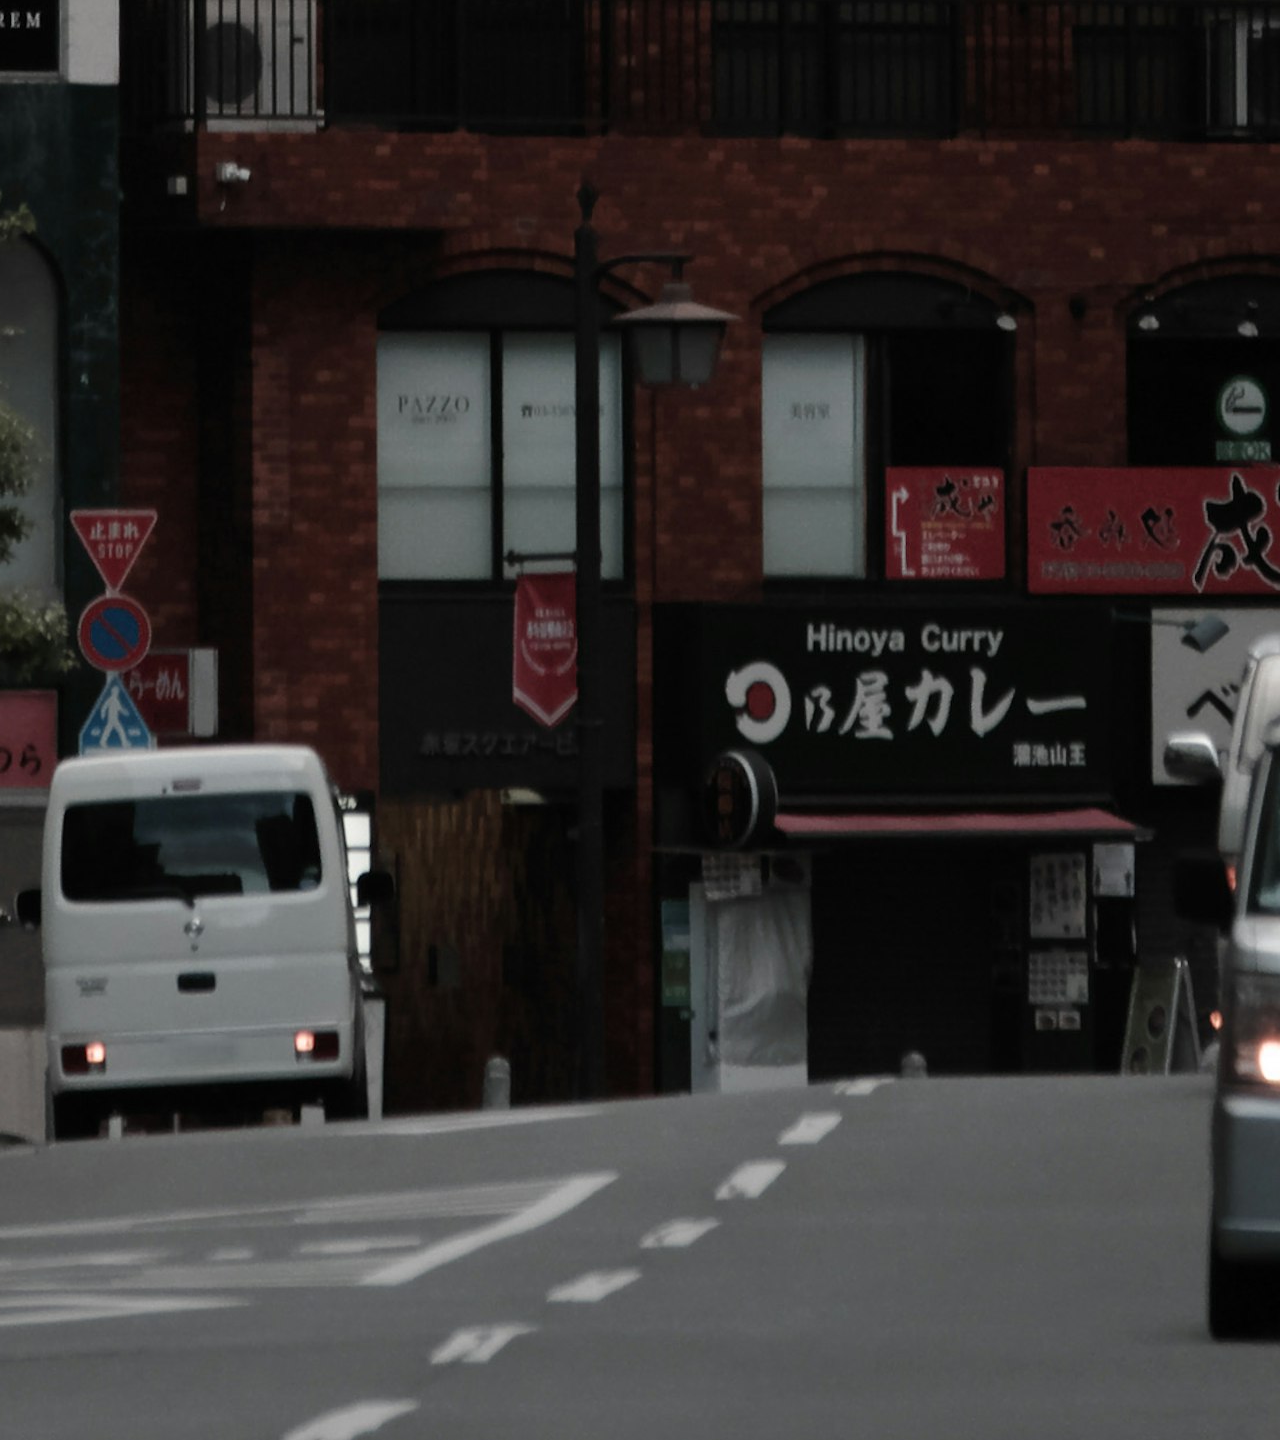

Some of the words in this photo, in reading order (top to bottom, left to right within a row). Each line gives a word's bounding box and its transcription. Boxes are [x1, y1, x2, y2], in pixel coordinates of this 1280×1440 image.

[397, 394, 472, 415] PAZZO
[89, 520, 140, 542] 止まれ
[96, 544, 134, 560] STOP
[805, 622, 905, 657] Hinoya
[920, 622, 1005, 658] Curry
[1012, 742, 1087, 768] 溜池山王
